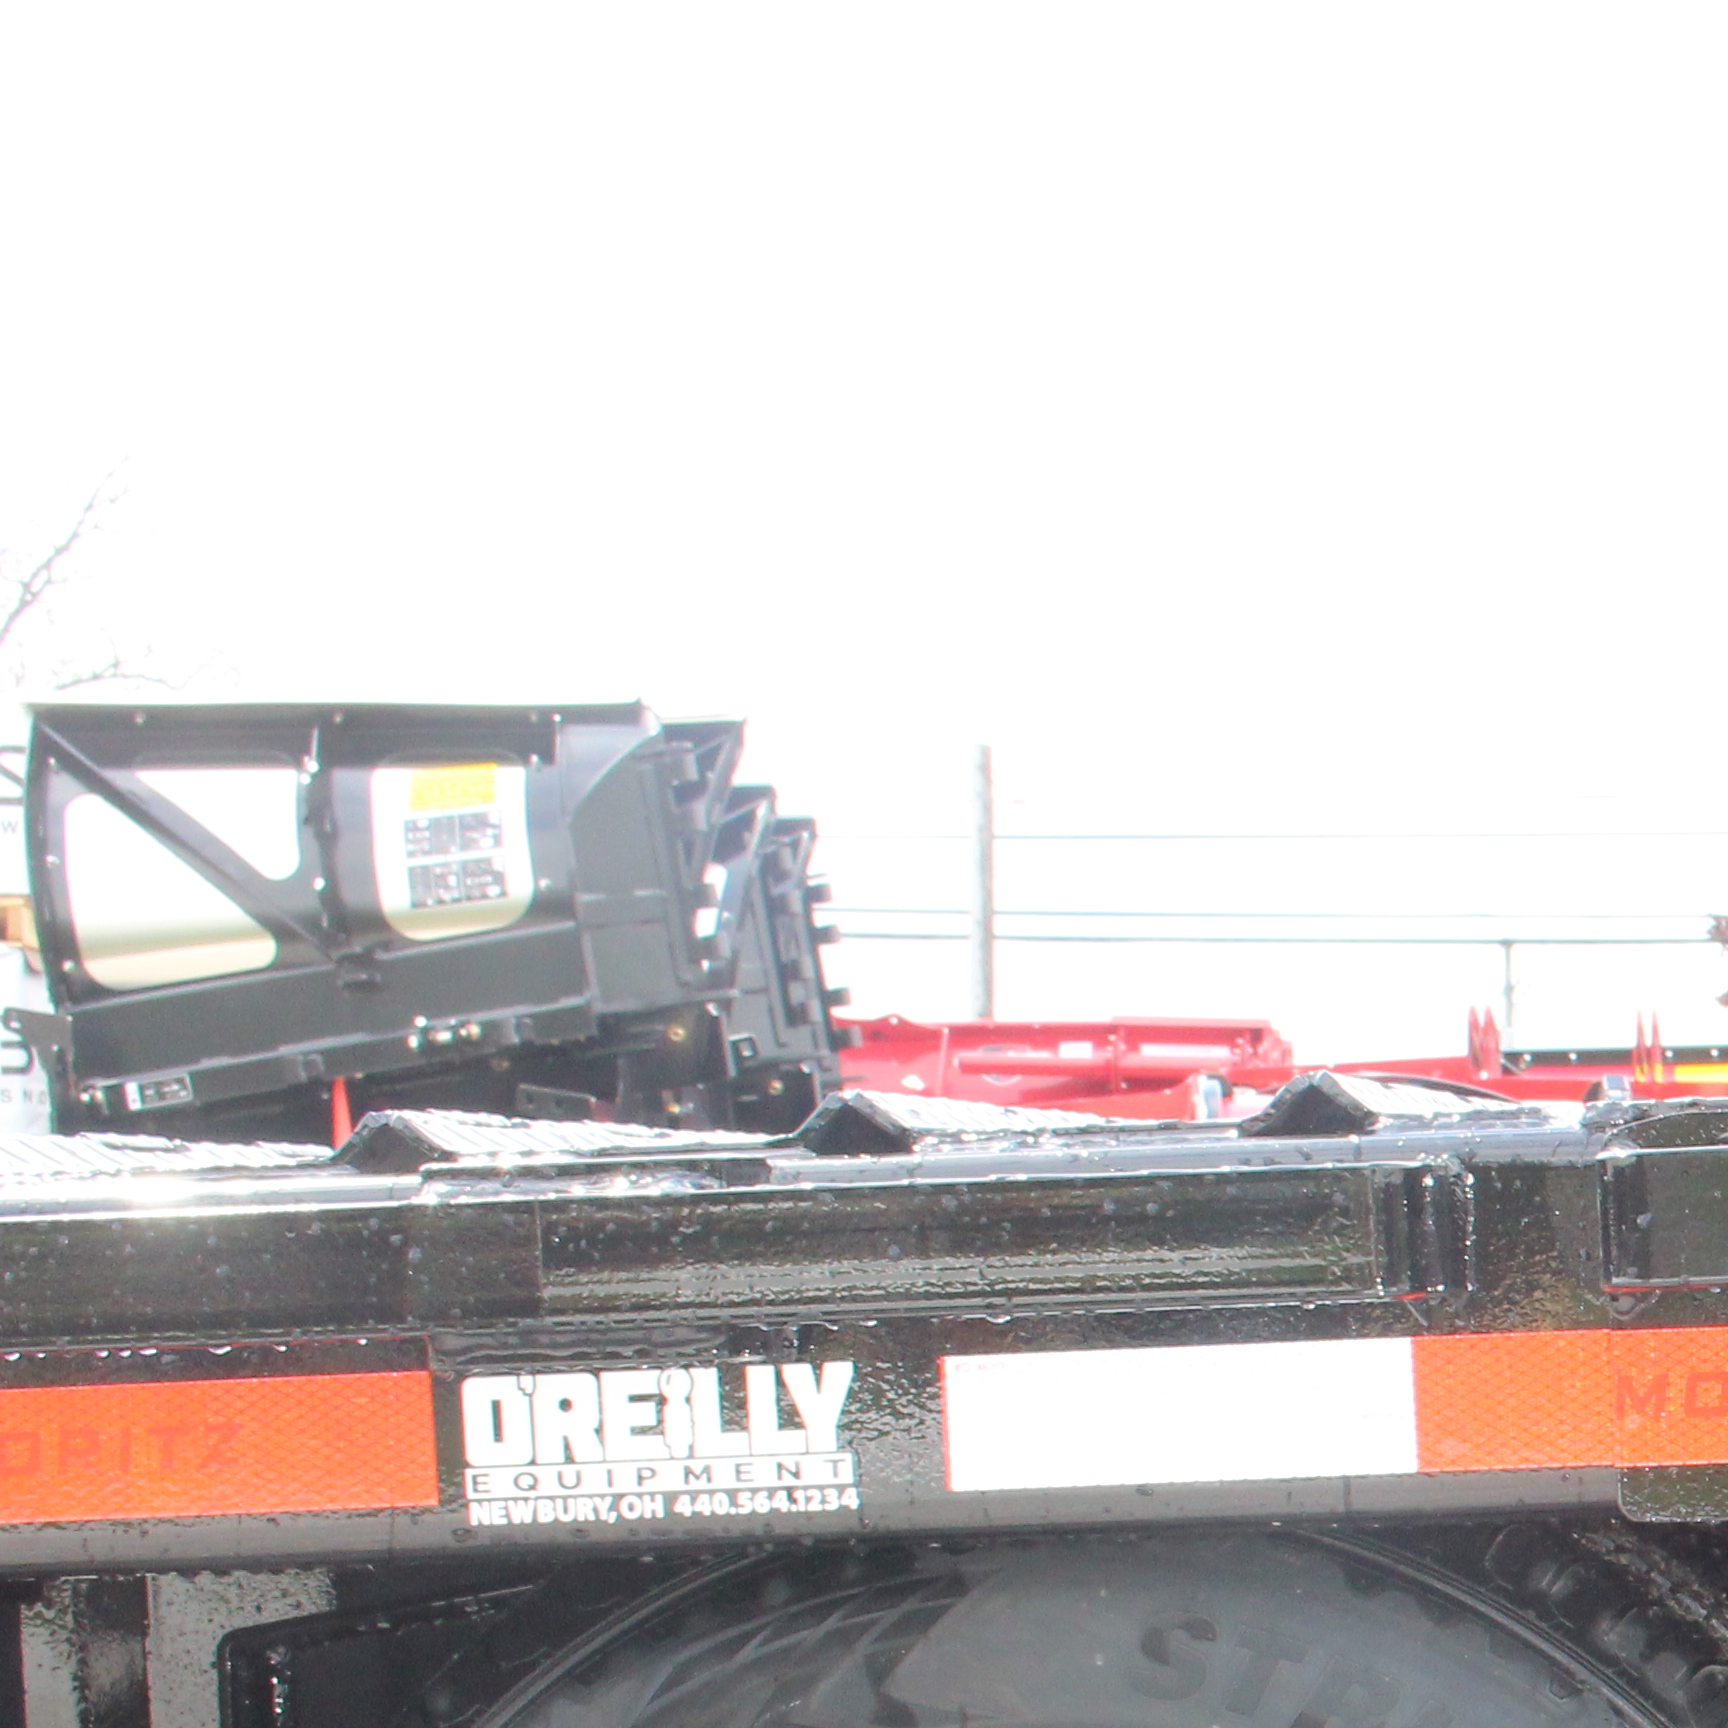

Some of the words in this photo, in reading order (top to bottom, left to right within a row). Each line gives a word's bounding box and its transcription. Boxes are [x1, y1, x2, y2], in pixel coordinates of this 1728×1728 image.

[0, 1418, 245, 1477] ORITZ
[471, 1458, 846, 1494] EQUIPMENT
[673, 1487, 861, 1517] 440.564.1234
